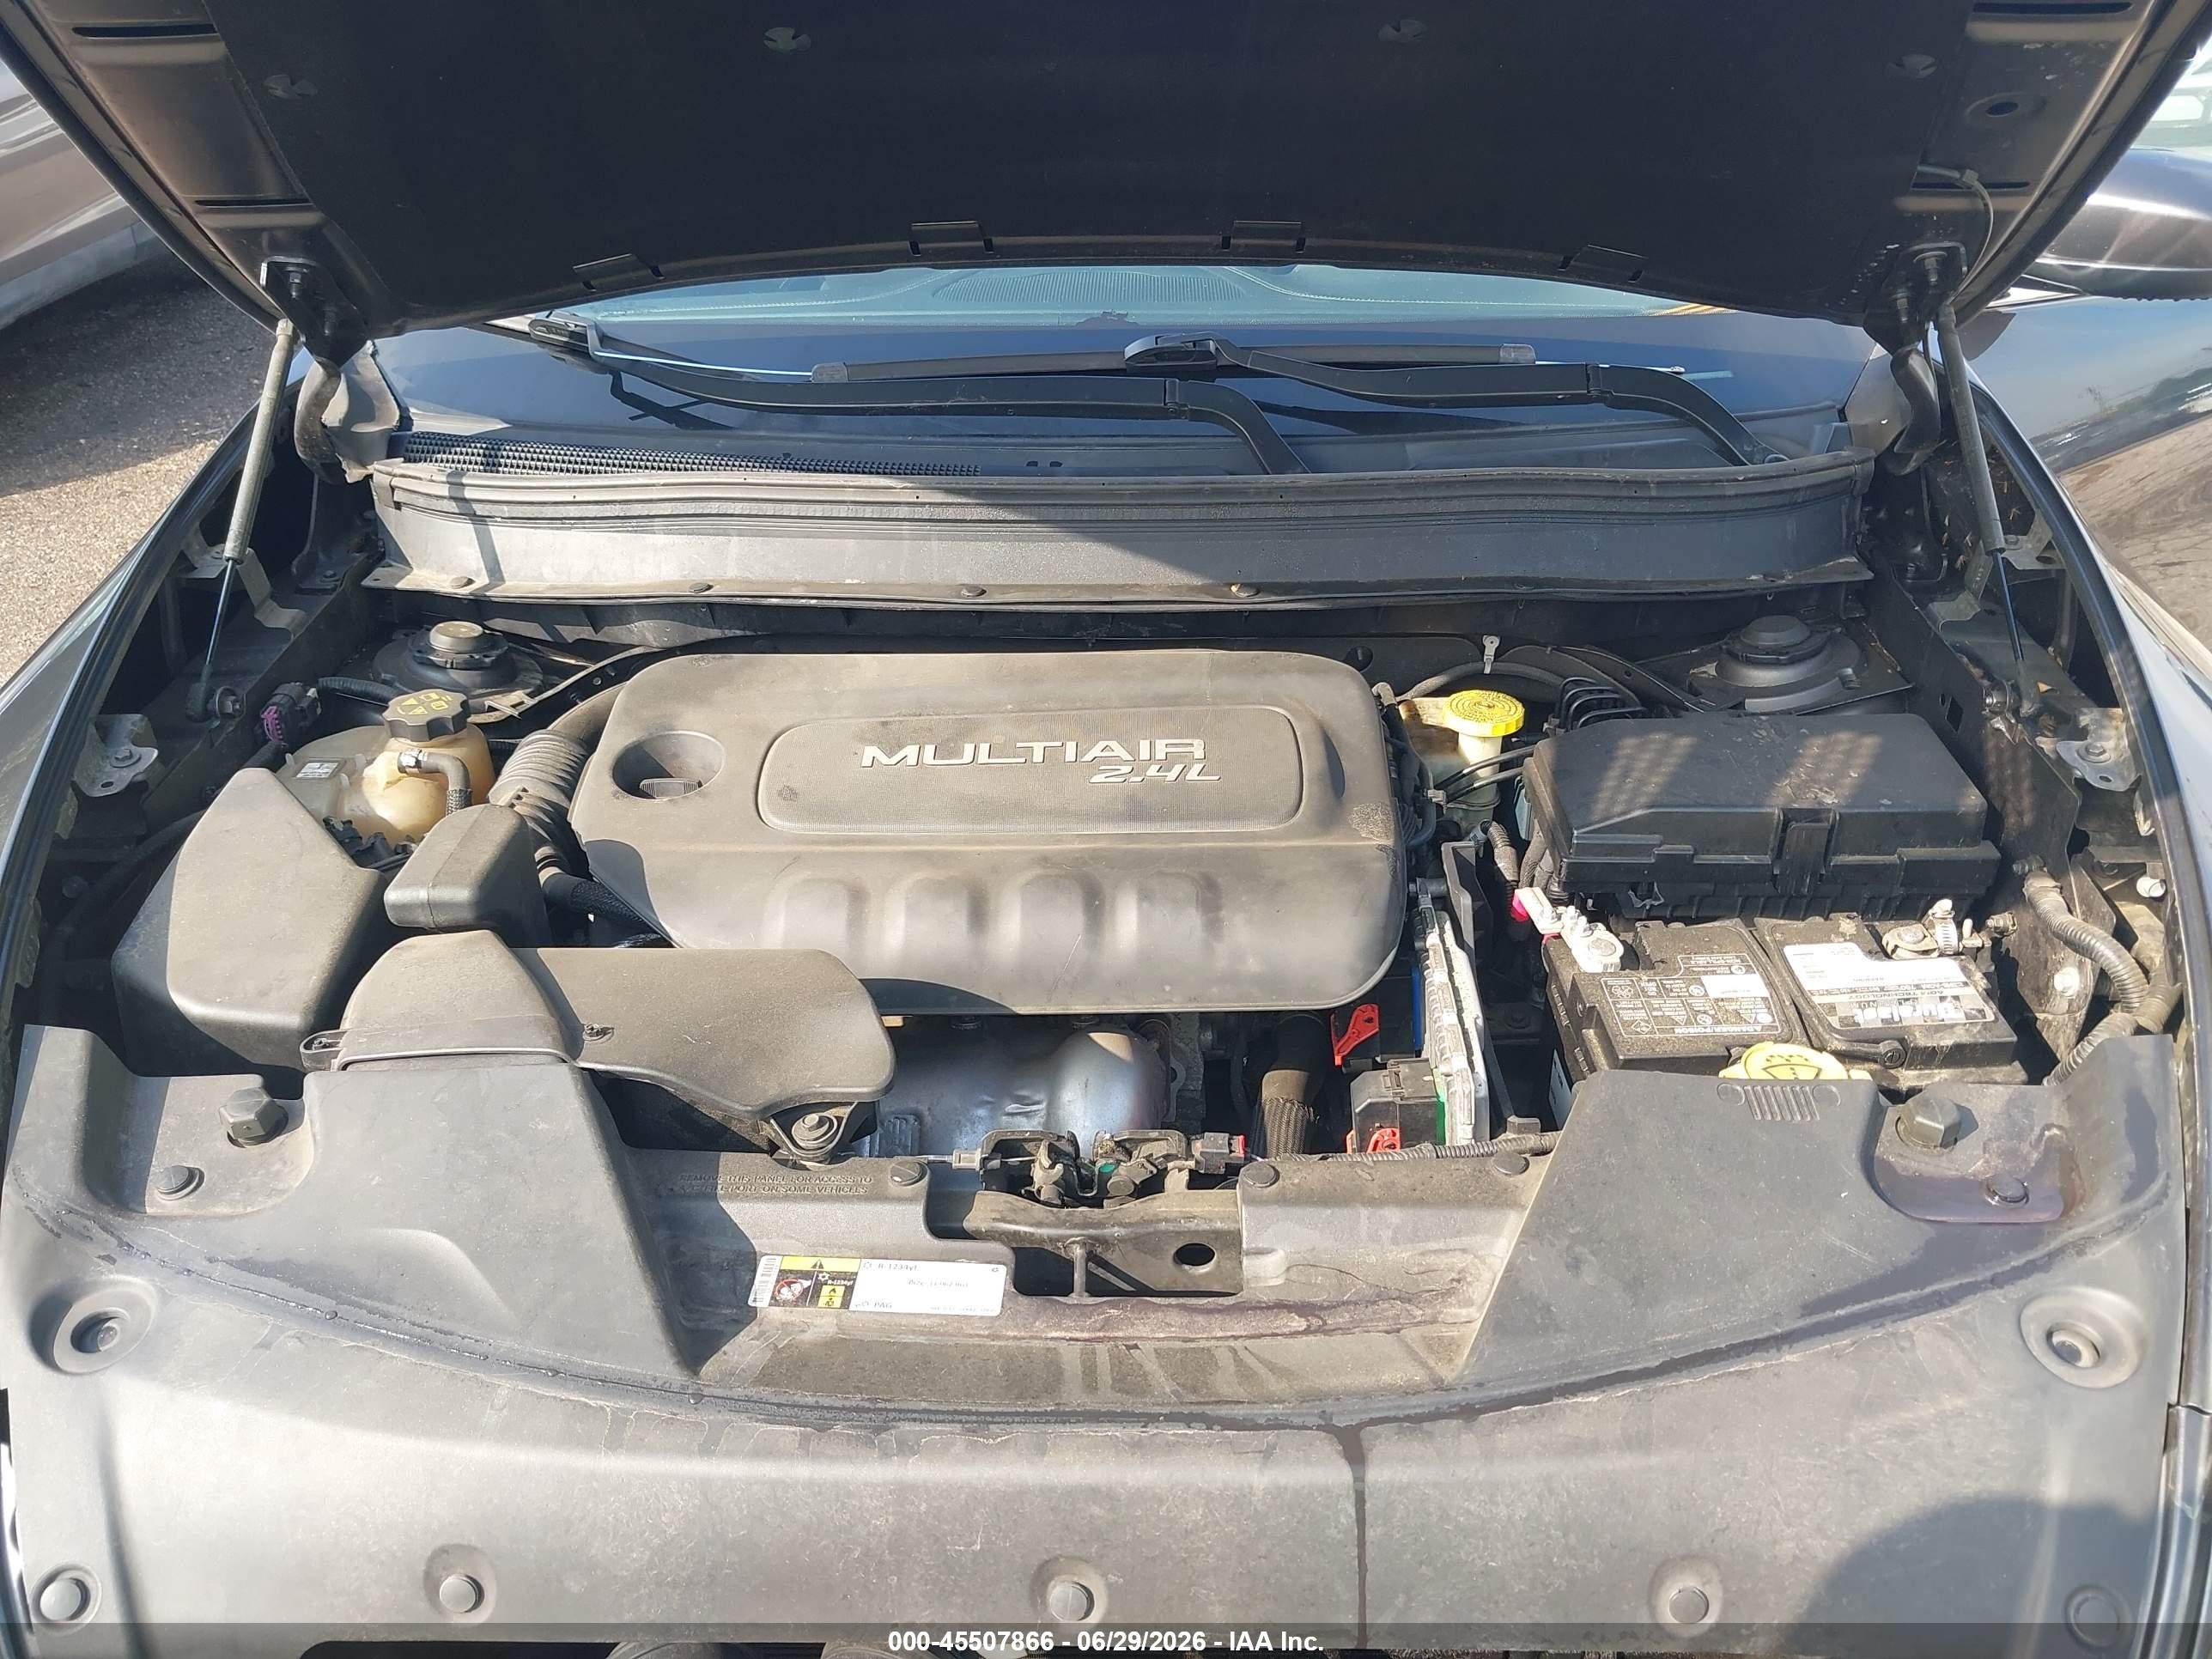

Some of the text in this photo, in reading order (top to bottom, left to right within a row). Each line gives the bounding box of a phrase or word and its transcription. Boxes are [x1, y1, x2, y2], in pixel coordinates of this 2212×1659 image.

[860, 739, 1206, 768] MULTIAIR
[1088, 764, 1221, 784] 2.4L
[727, 1174, 751, 1182] THIS
[754, 1174, 787, 1183] PANEL
[790, 1175, 812, 1183] FOR
[814, 1176, 856, 1184] ACCESS
[763, 1185, 779, 1194] ON
[781, 1185, 813, 1194] SOME
[816, 1185, 869, 1195] VEHICLES
